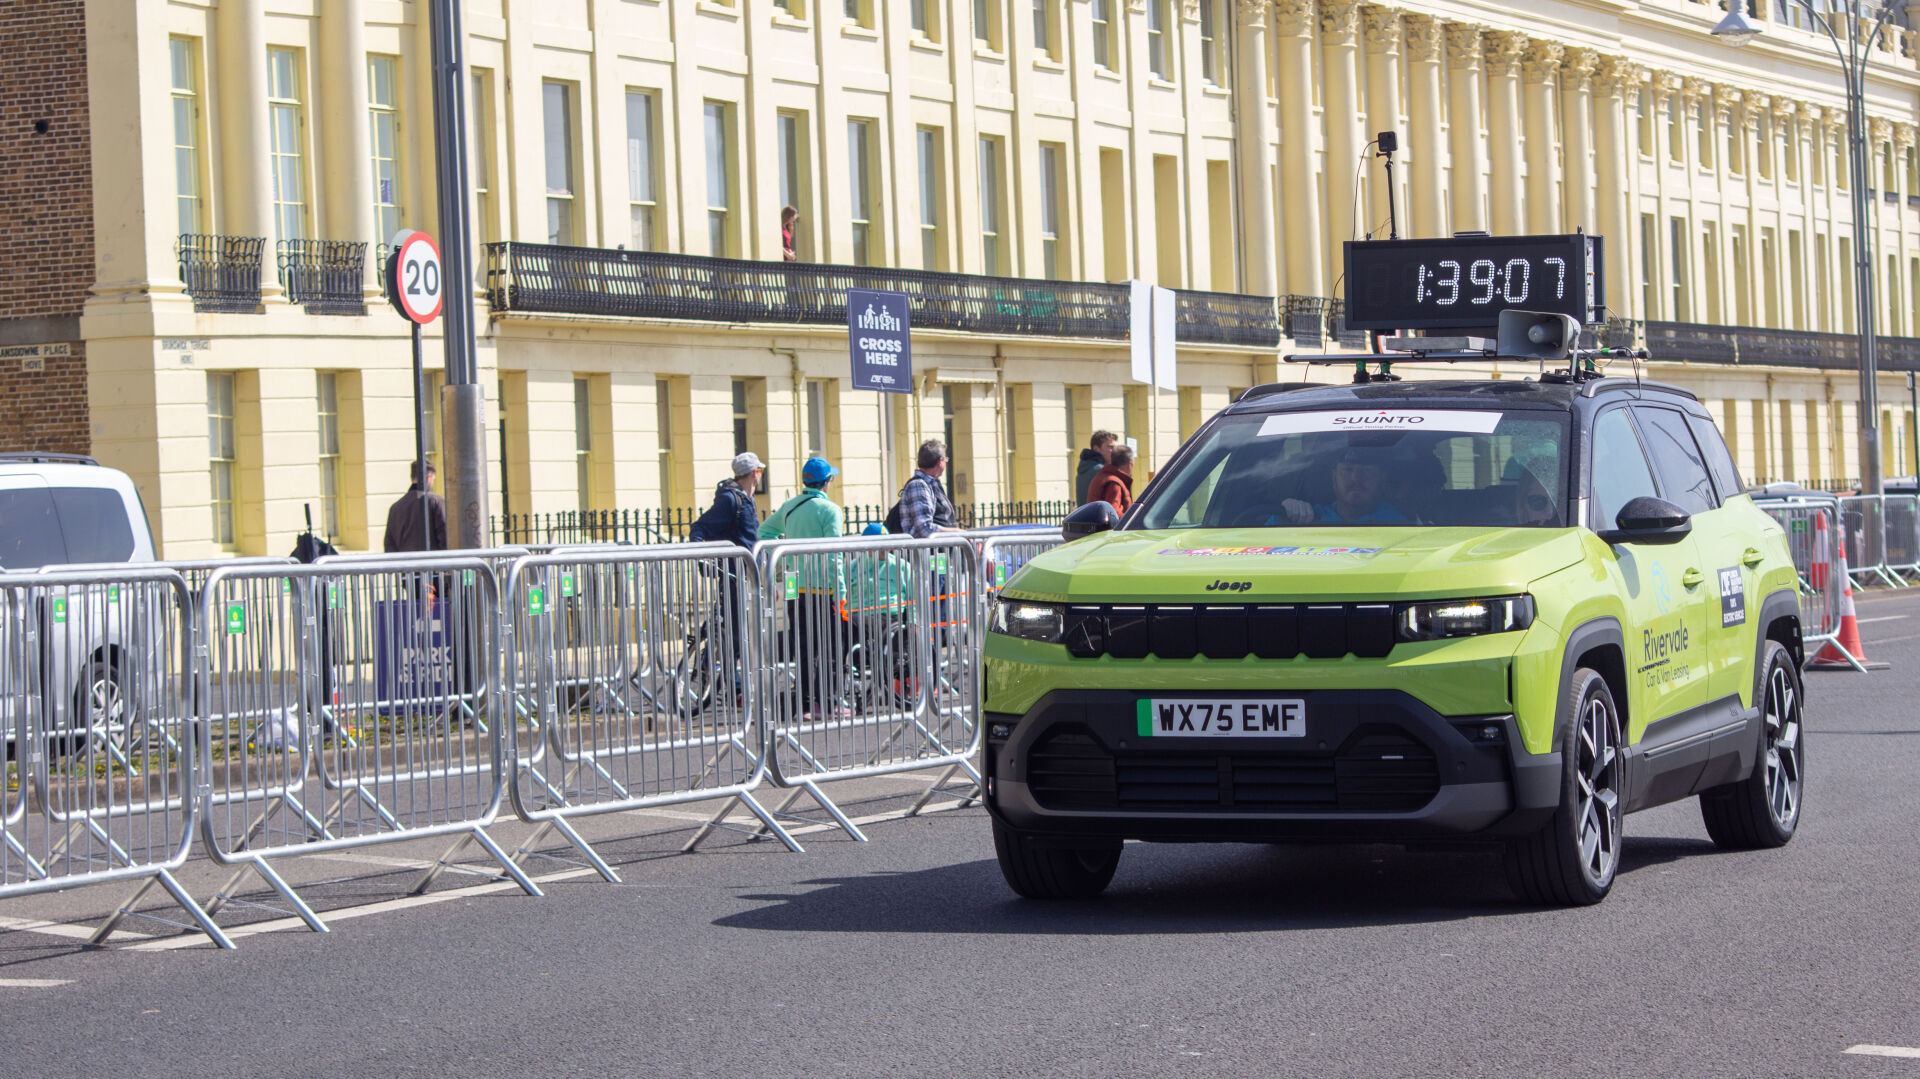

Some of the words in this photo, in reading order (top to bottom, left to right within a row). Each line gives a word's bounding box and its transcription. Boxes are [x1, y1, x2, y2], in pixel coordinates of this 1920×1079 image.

[406, 259, 439, 296] 20
[0, 346, 40, 357] ANSDOWNE
[44, 344, 69, 355] PLACE
[859, 337, 902, 353] CROSS
[24, 359, 42, 369] HOVE
[865, 351, 898, 366] HERE
[1332, 416, 1425, 425] SUUNTO
[1206, 580, 1252, 592] Jeep
[1643, 618, 1689, 662] Rivervale
[1646, 671, 1656, 688] Car
[1661, 667, 1671, 683] Van
[1671, 662, 1690, 681] Leasing
[1159, 704, 1233, 731] WX75
[1242, 704, 1299, 731] EMF
